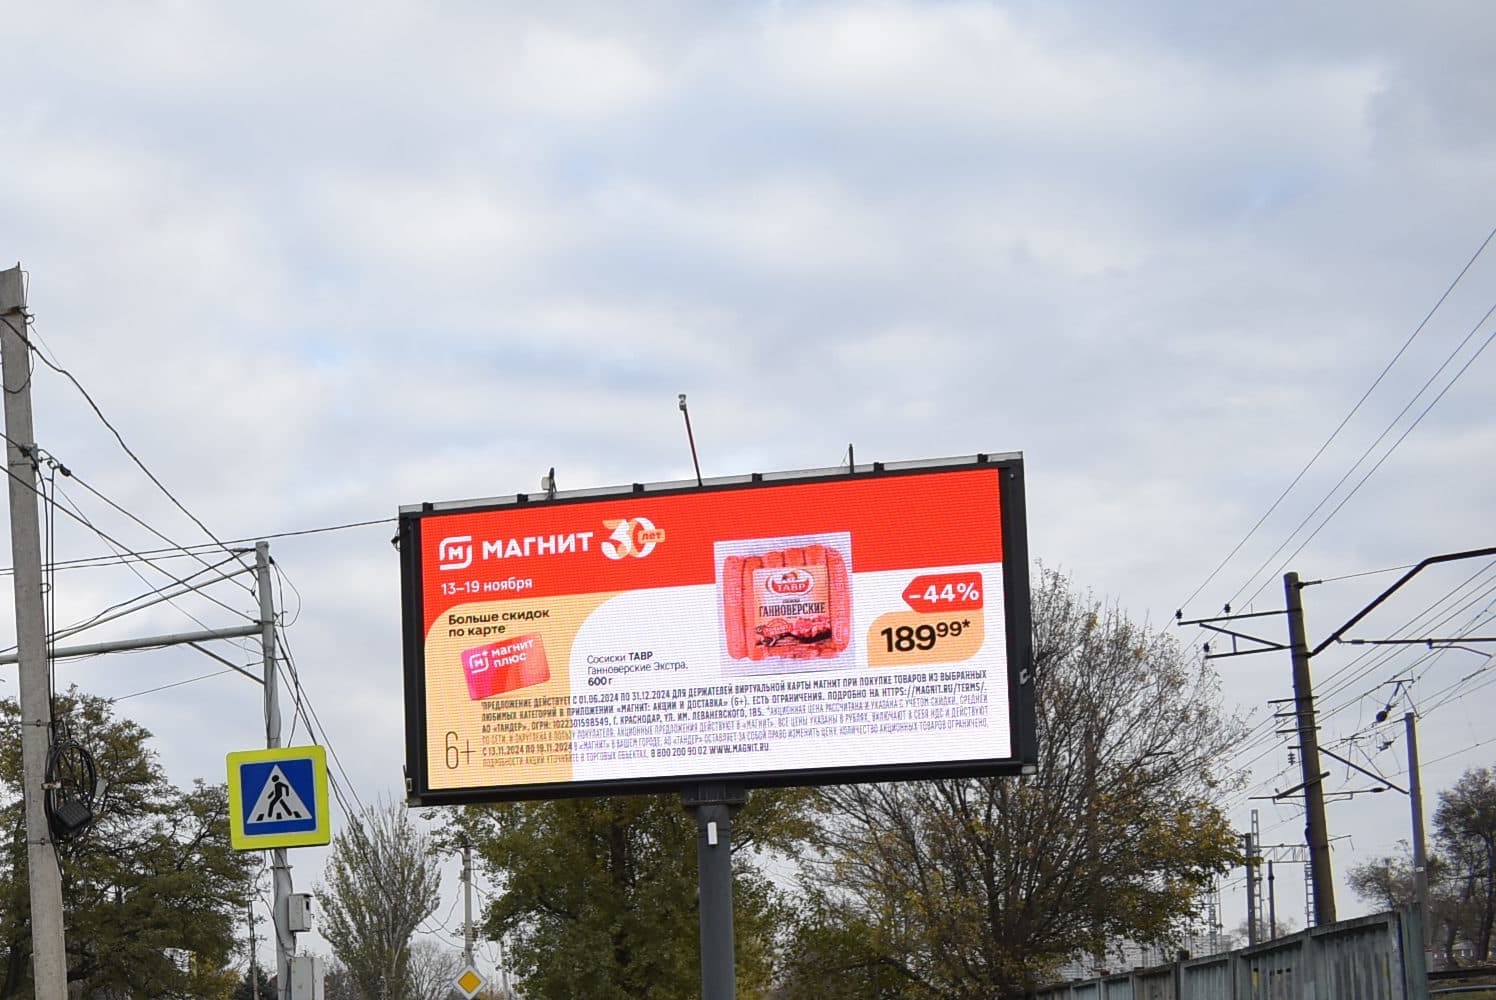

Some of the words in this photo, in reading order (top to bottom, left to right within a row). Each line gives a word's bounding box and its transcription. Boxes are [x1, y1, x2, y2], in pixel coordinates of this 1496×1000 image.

[482, 531, 593, 560] МАГНИТ
[601, 517, 657, 560] 30
[483, 575, 532, 594] ноября
[777, 582, 806, 591] ТАВР
[448, 611, 498, 625] Больше
[501, 608, 550, 622] скидок
[448, 628, 465, 637] по
[468, 624, 505, 637] карте
[494, 652, 527, 668] плюс
[586, 652, 625, 664] Сосиски
[628, 651, 653, 661] ТАВР
[587, 662, 650, 677] Ганноверские
[587, 676, 607, 686] 600
[620, 691, 630, 701] ПО
[671, 688, 686, 699] ДЛЯ
[687, 683, 732, 698] ДЕРЖАТЕЛЕЙ
[734, 679, 784, 694] ВИРТУАЛЬНОЙ
[787, 679, 811, 691] КАРТЫ
[813, 678, 840, 689] МАГНИТ
[843, 676, 858, 687] ПРИ
[859, 674, 891, 686] ПОКУПКЕ
[893, 672, 926, 684] ТОВАРОВ
[928, 671, 938, 682] ИЗ
[940, 668, 986, 681] ВЫБРАННЫХ
[652, 701, 676, 712] АКЦИИ
[752, 695, 769, 705] ЕСТЬ
[827, 689, 866, 701] ПОДРОБНО
[869, 688, 879, 697] НА
[481, 724, 490, 733] АО
[444, 729, 476, 770] 6+
